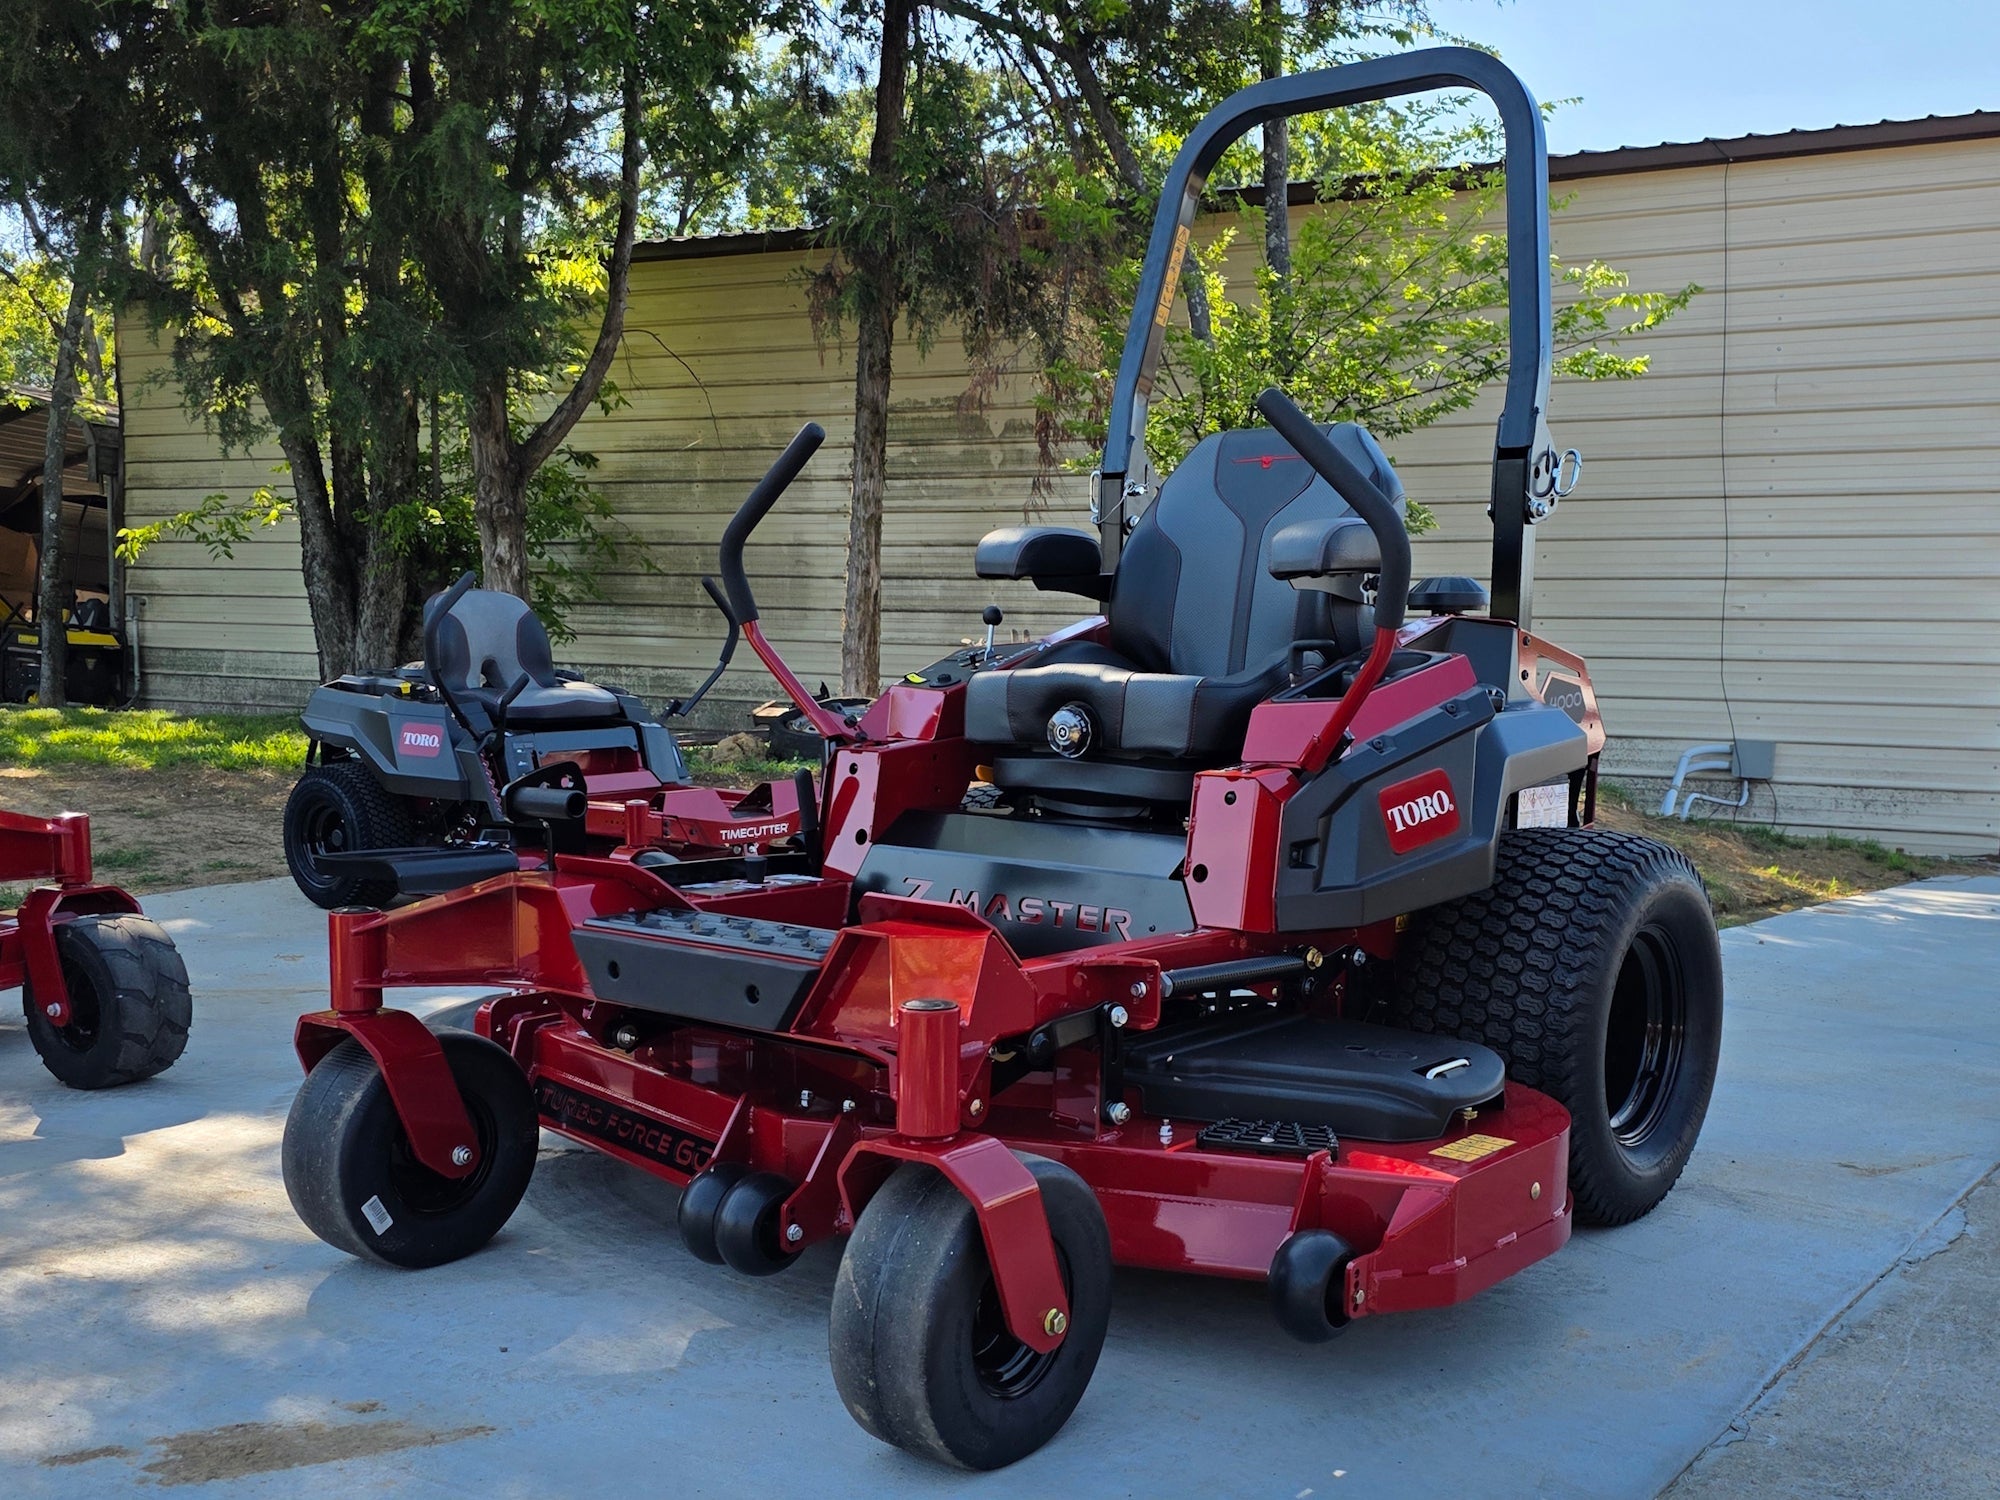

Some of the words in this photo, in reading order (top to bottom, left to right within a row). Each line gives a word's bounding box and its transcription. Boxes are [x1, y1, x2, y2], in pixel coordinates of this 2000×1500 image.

[403, 732, 439, 747] TORO
[720, 823, 788, 839] TIMECUTTER
[951, 888, 1132, 942] MASTER
[543, 1087, 603, 1126] TURBO
[605, 1113, 673, 1155] FORCE
